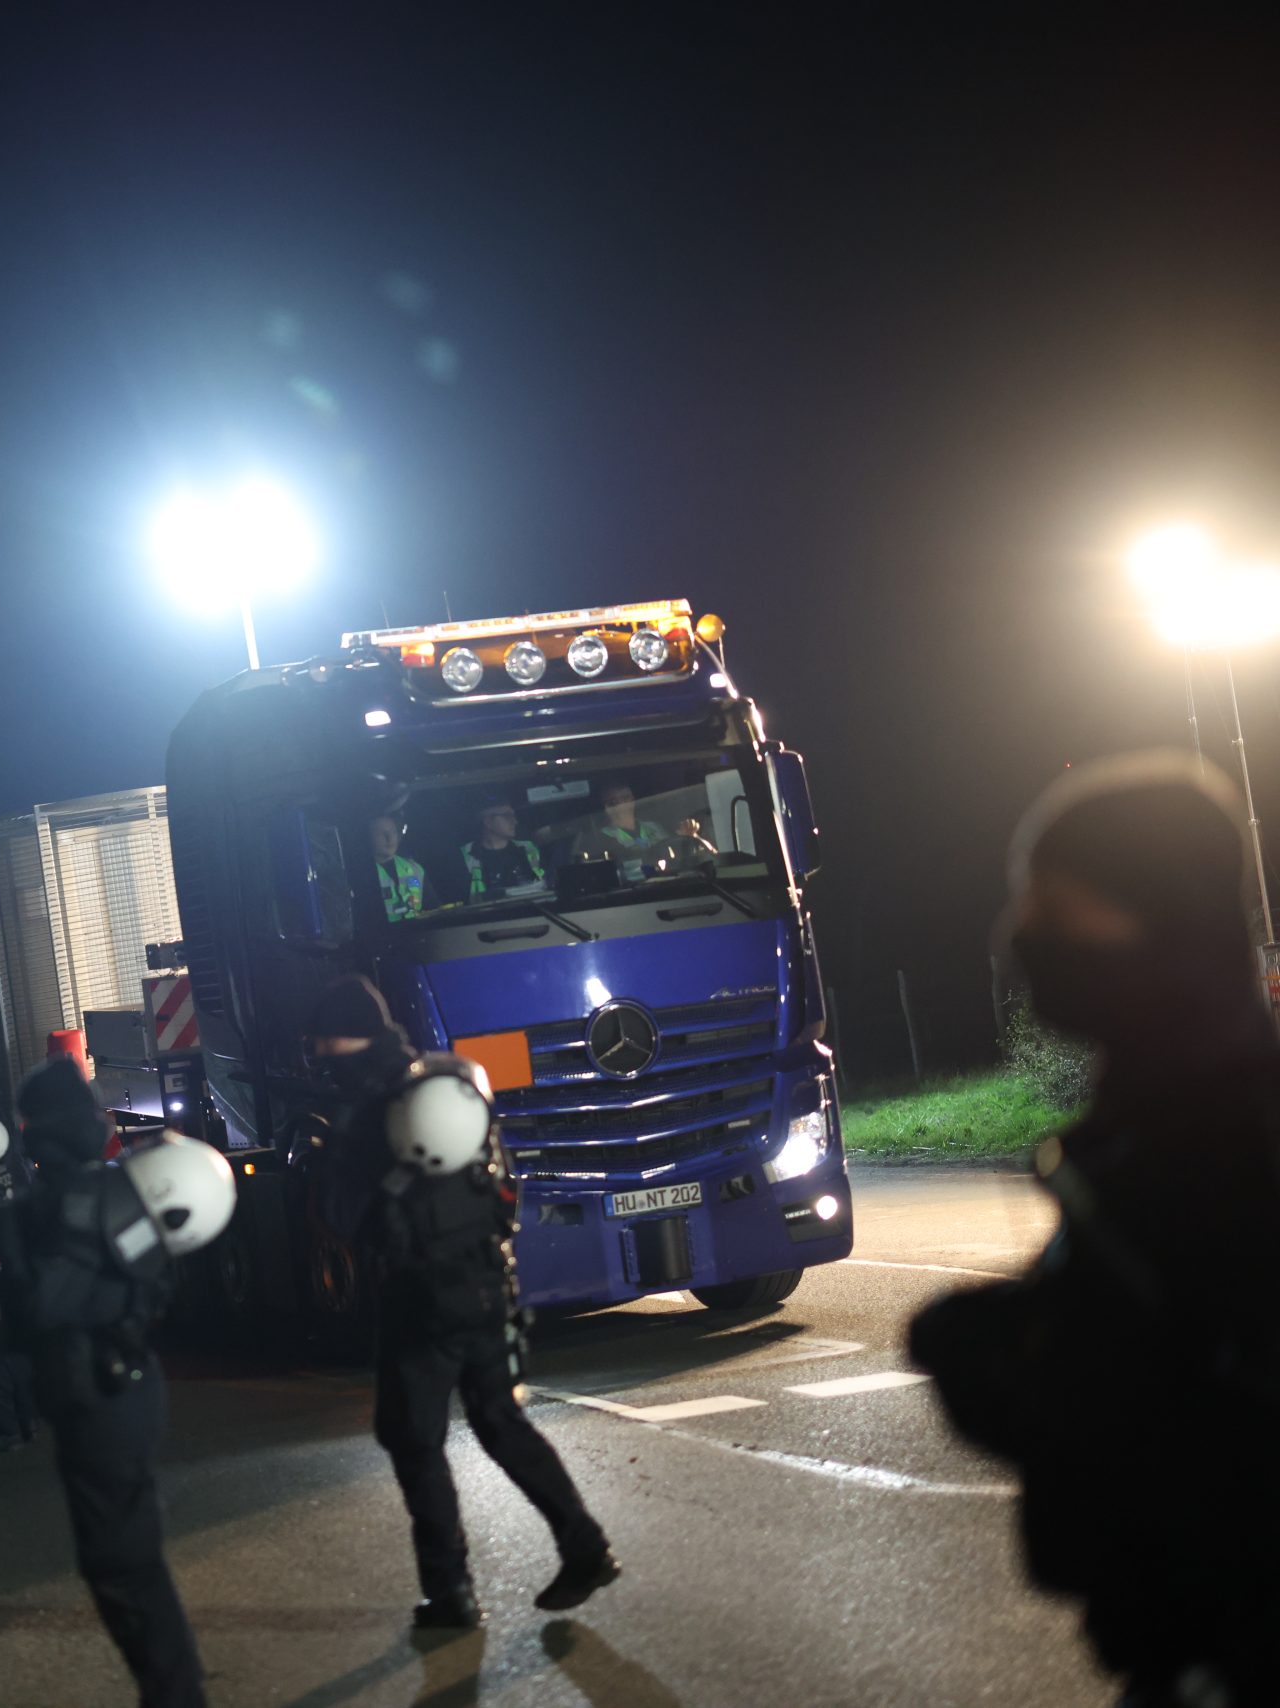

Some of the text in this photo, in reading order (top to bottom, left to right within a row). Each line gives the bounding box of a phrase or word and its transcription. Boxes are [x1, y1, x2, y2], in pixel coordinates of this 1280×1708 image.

[614, 1185, 700, 1213] HU NT 202
